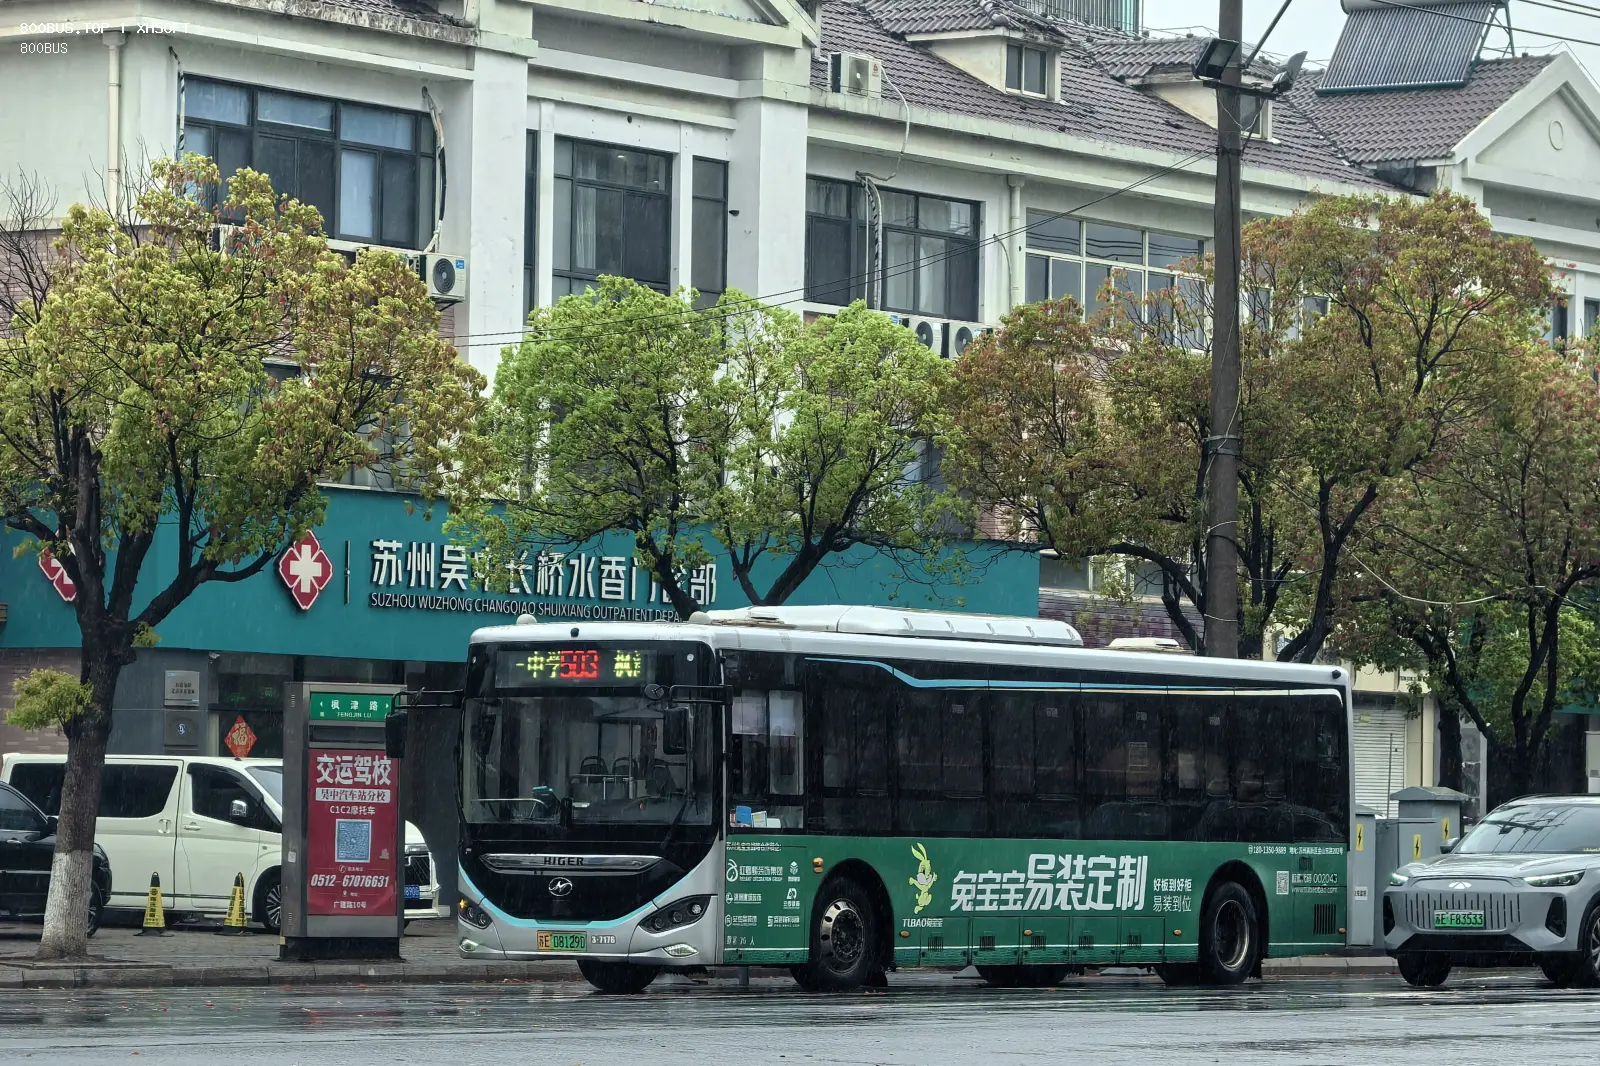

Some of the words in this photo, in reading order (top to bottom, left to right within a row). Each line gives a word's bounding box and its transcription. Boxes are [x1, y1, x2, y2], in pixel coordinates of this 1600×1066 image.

[371, 592, 416, 608] SUZHOU
[418, 595, 472, 612] WUZHONG
[538, 602, 595, 618] SHUIXIANG
[592, 605, 653, 622] OUTPATIENT
[560, 649, 599, 679] 503
[316, 753, 392, 786] 交运驾校
[321, 788, 386, 802] 吴中汽车站分校
[329, 805, 376, 816] C1C2摩托车
[543, 856, 584, 866] HIGER
[310, 873, 390, 888] 0512-67076631
[950, 853, 1149, 911] 兔宝宝易装定制
[1153, 877, 1193, 892] 好板到好柜
[1152, 894, 1192, 913] 易装到位
